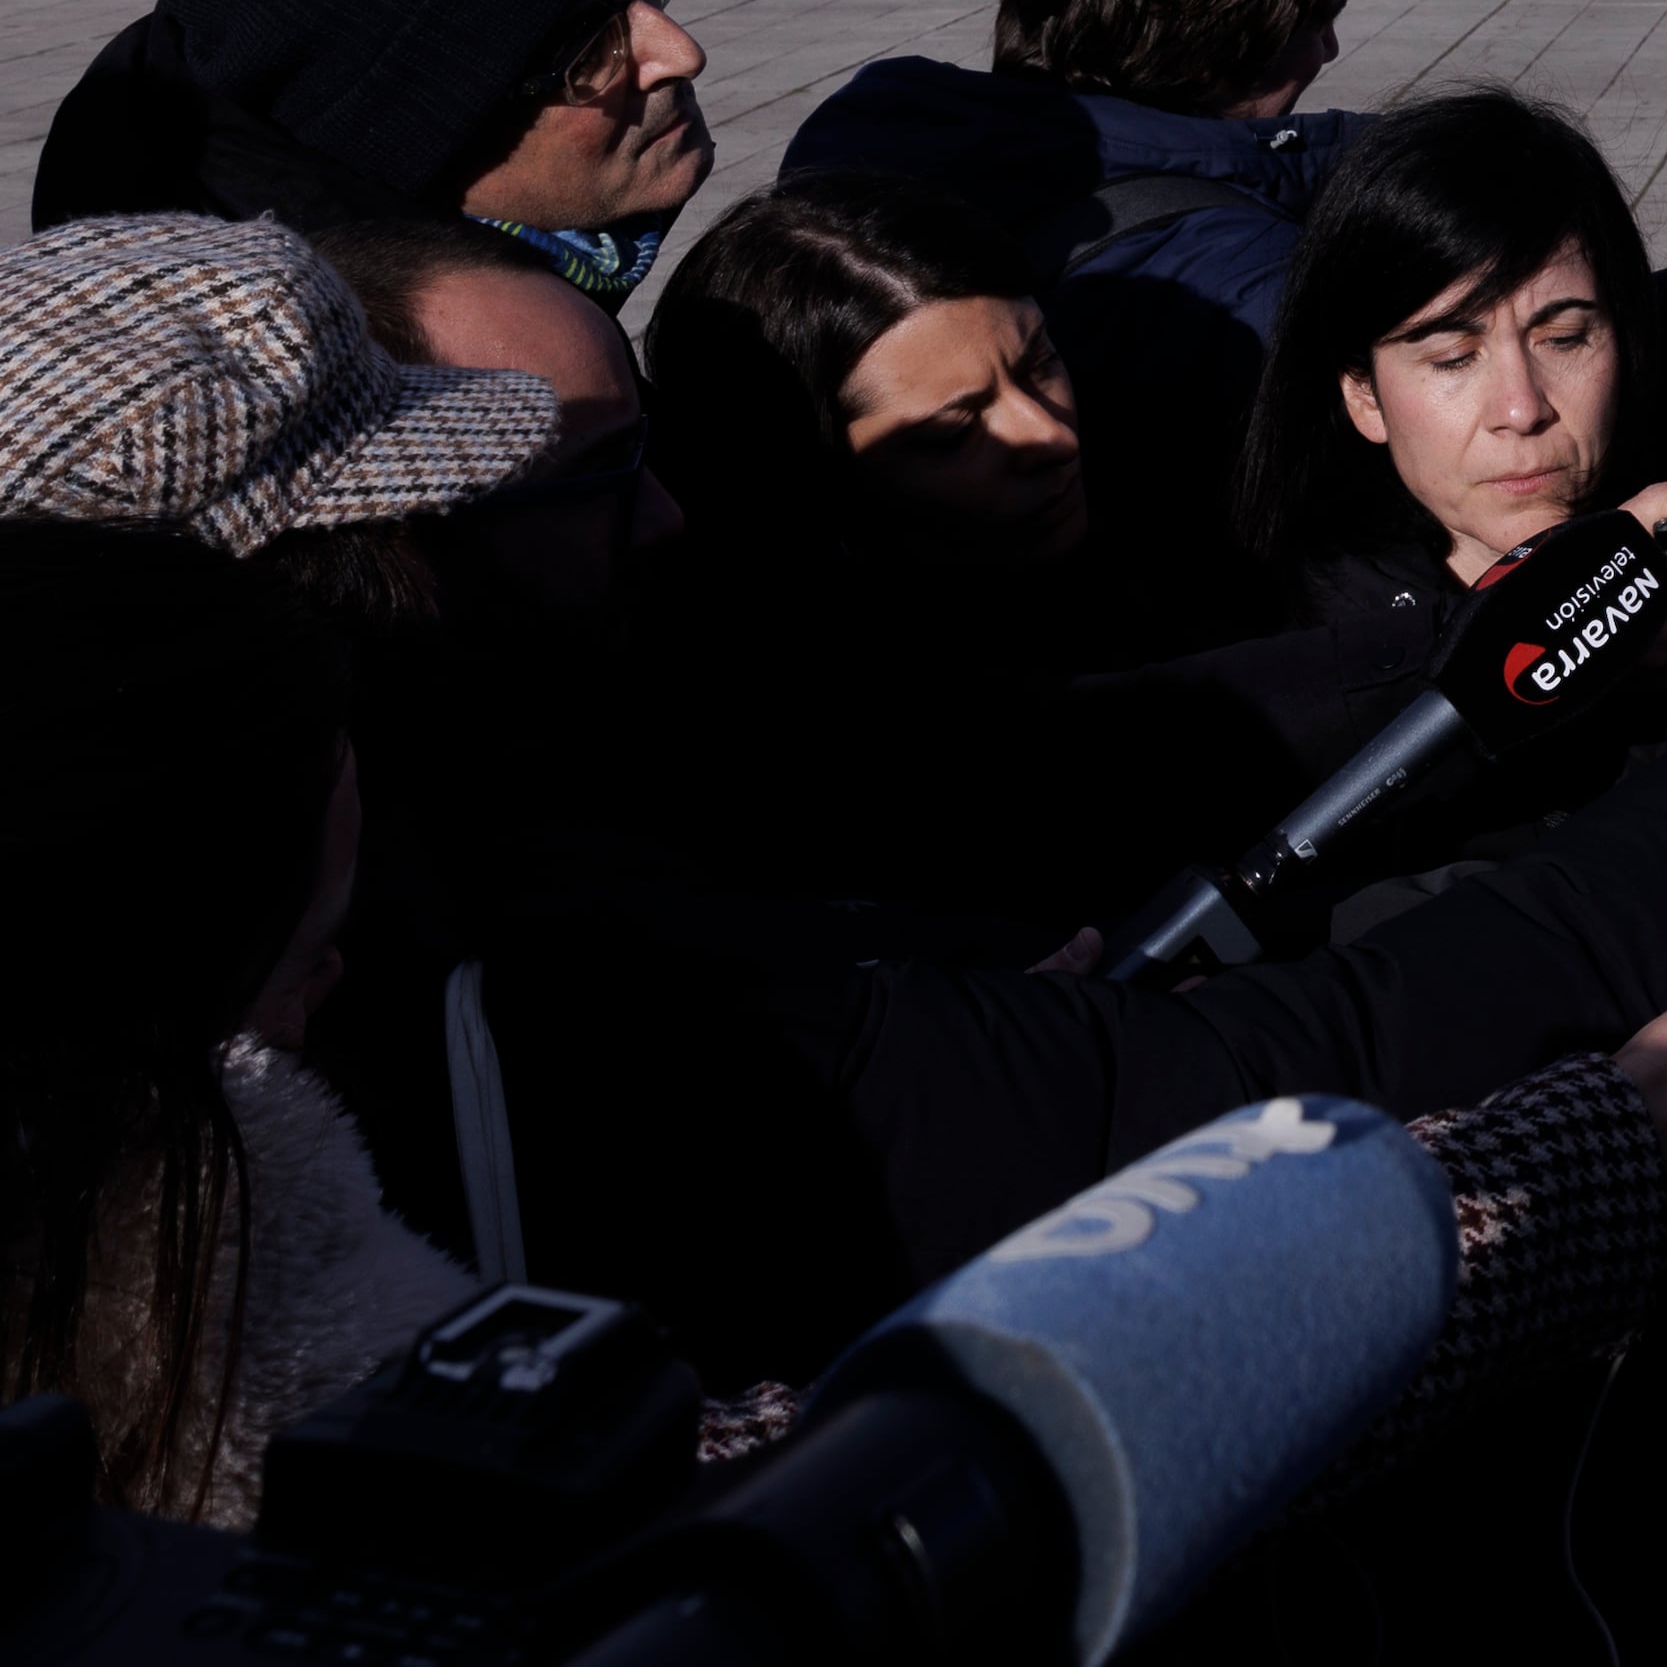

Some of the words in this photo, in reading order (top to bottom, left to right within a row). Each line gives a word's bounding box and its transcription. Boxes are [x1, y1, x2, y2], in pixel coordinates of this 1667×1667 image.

[1531, 568, 1660, 691] Navarra
[1546, 546, 1637, 630] televisión
[1337, 787, 1382, 827] SENNHEISER
